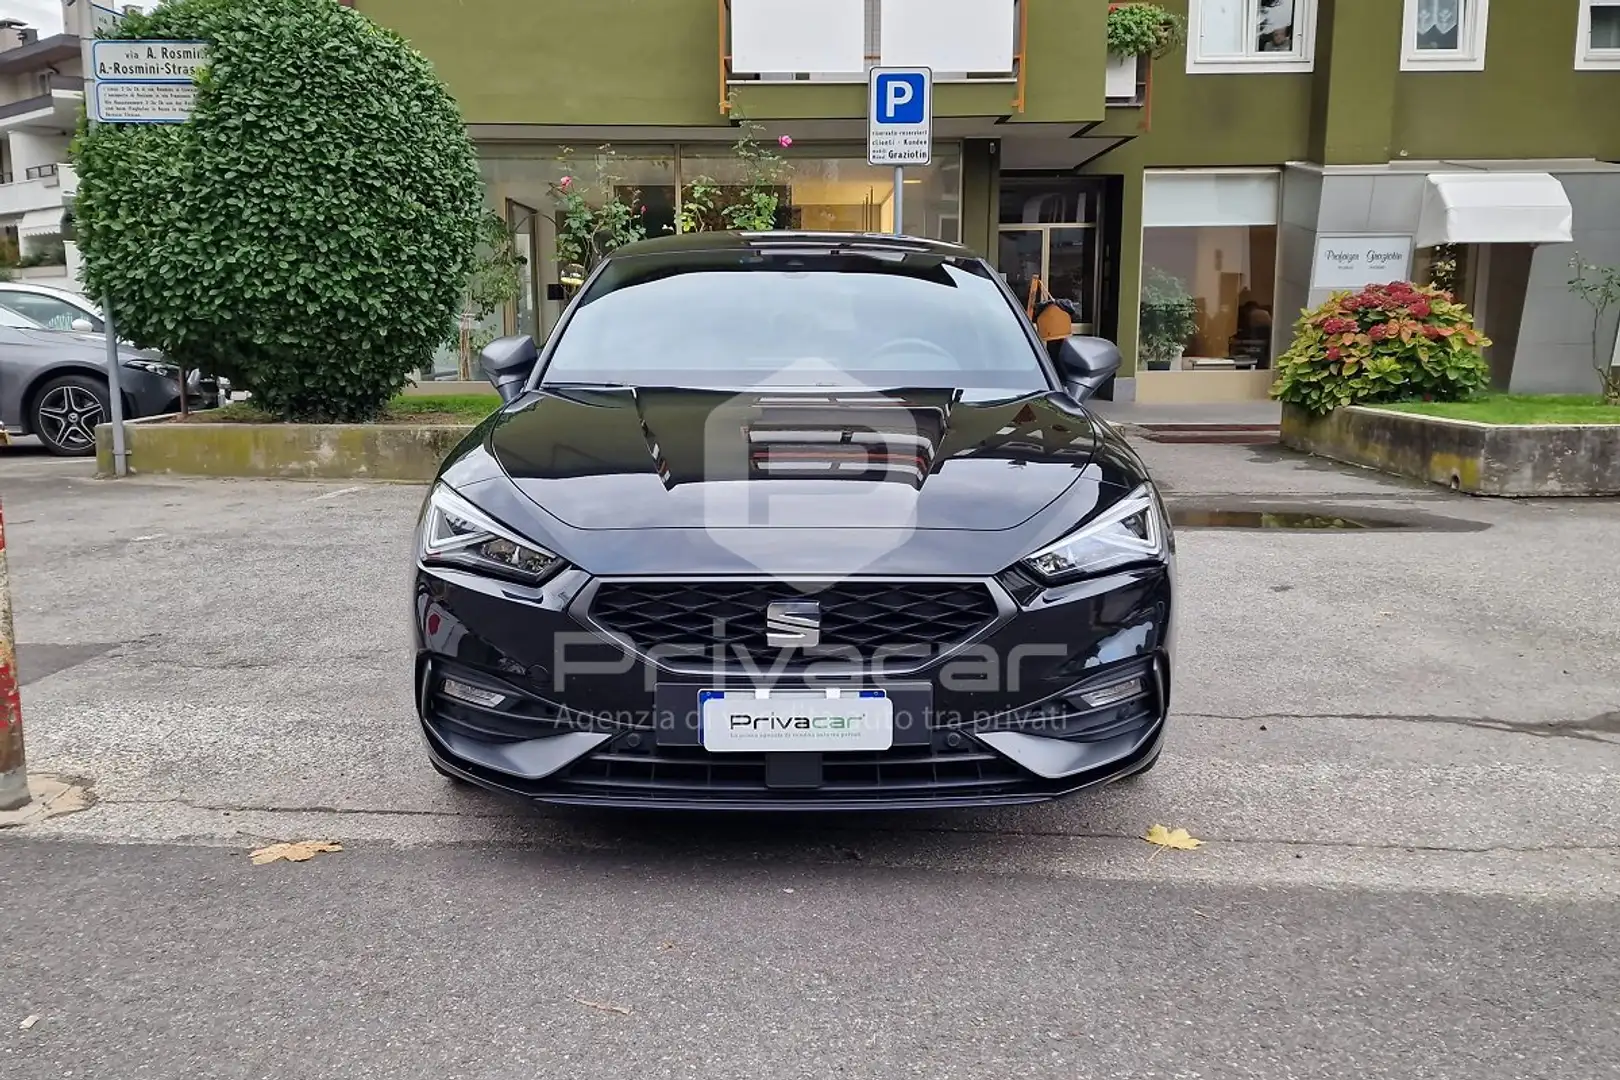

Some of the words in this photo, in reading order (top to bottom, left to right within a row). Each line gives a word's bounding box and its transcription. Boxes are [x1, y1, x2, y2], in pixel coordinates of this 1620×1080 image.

[125, 50, 139, 59] via
[147, 47, 157, 59] A.
[161, 47, 207, 59] Rosmin
[99, 62, 196, 75] A.-Rosmini-Stras
[886, 81, 914, 117] P
[888, 149, 928, 159] Graziotin
[730, 711, 863, 729] Privacar
